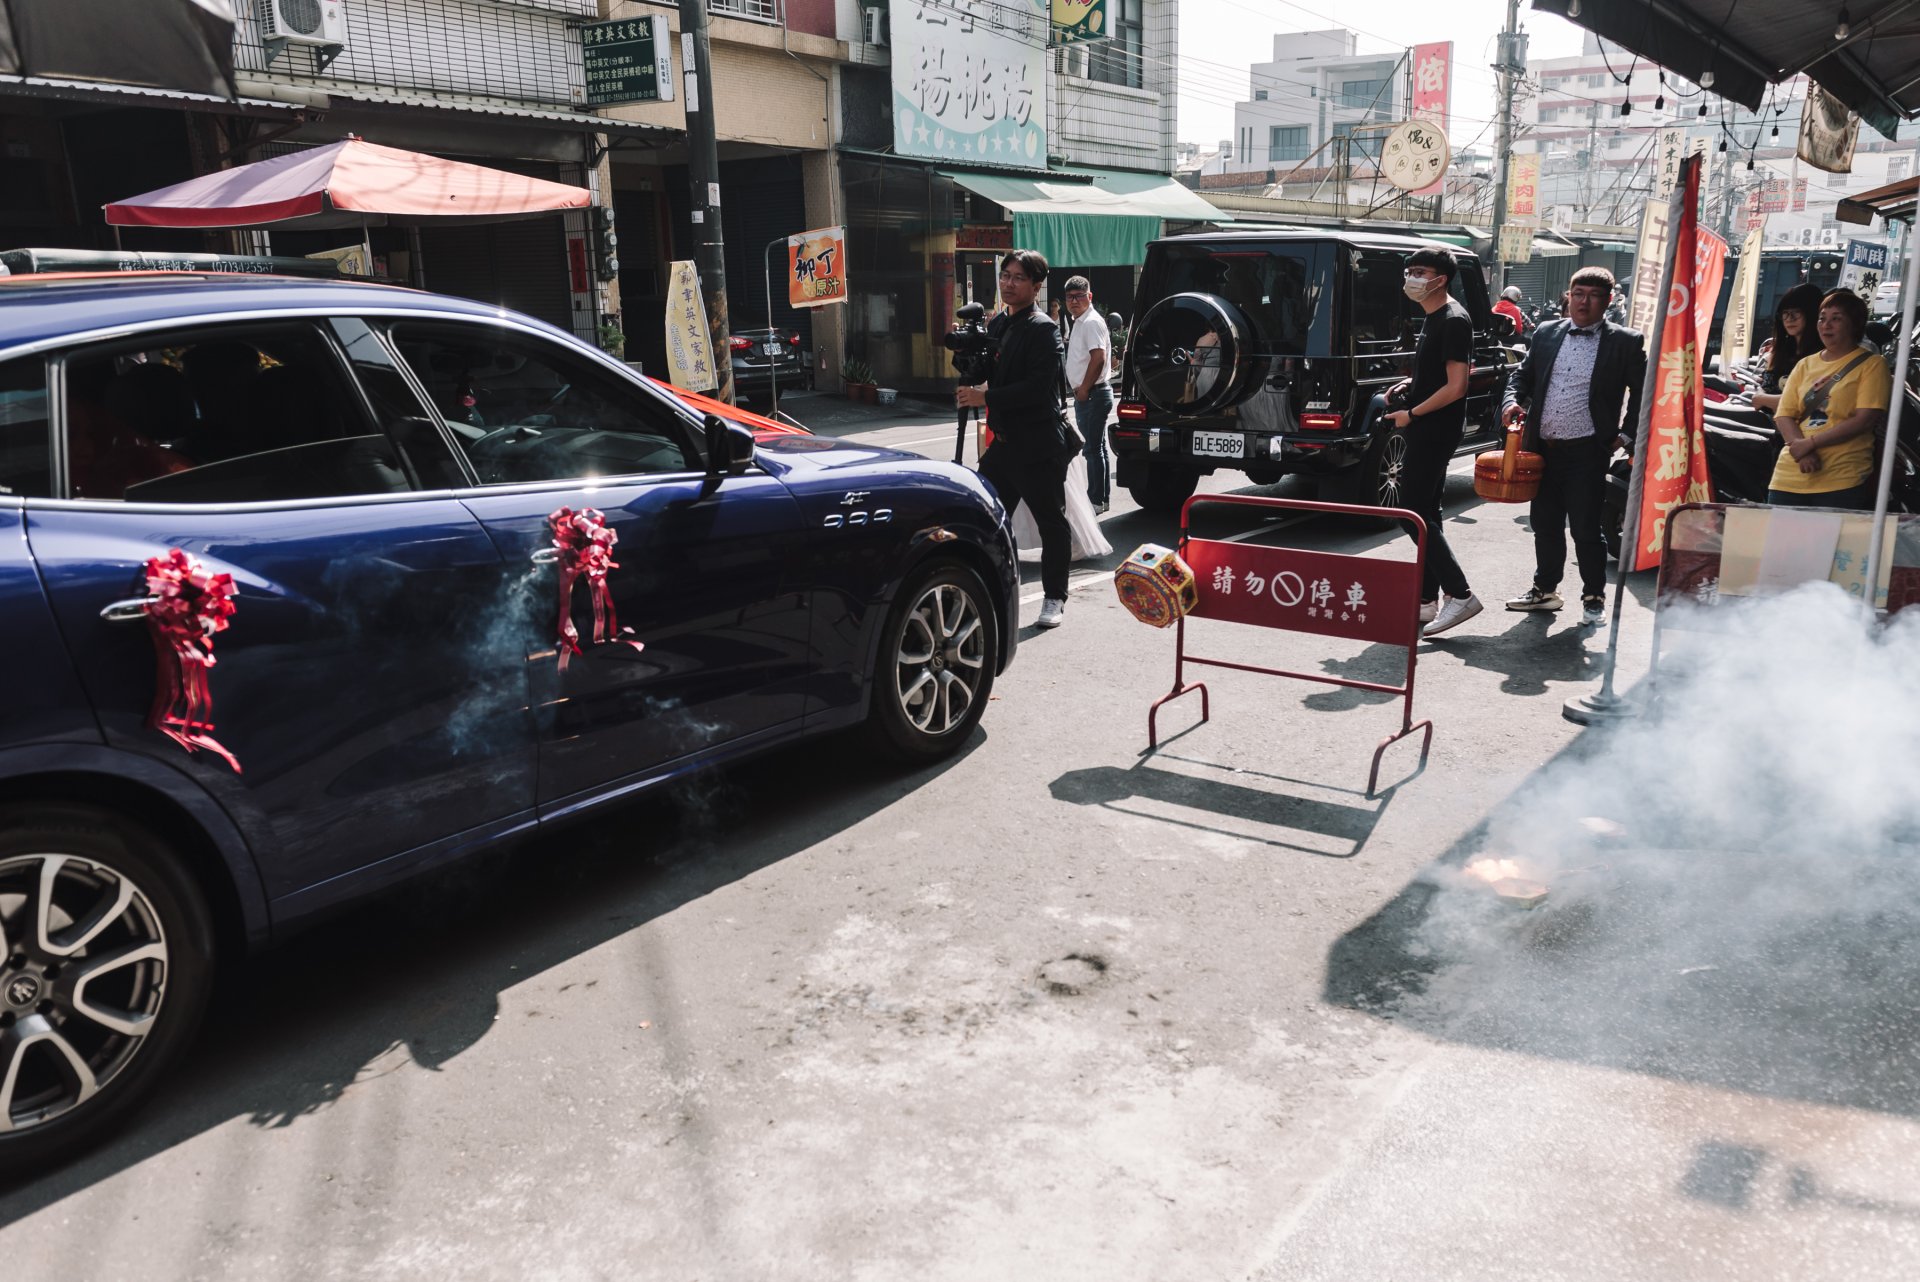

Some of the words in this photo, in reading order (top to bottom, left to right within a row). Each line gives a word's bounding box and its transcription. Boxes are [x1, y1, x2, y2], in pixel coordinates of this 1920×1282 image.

[910, 42, 1034, 128] 楊桃湯
[1513, 167, 1536, 215] 牛肉麵
[794, 247, 834, 282] 柳丁
[815, 277, 841, 297] 原汁
[1194, 436, 1243, 454] BLE-5889
[1211, 565, 1266, 596] 請勿
[1309, 578, 1368, 611] 停車
[1307, 606, 1368, 624] 謝謝合作
